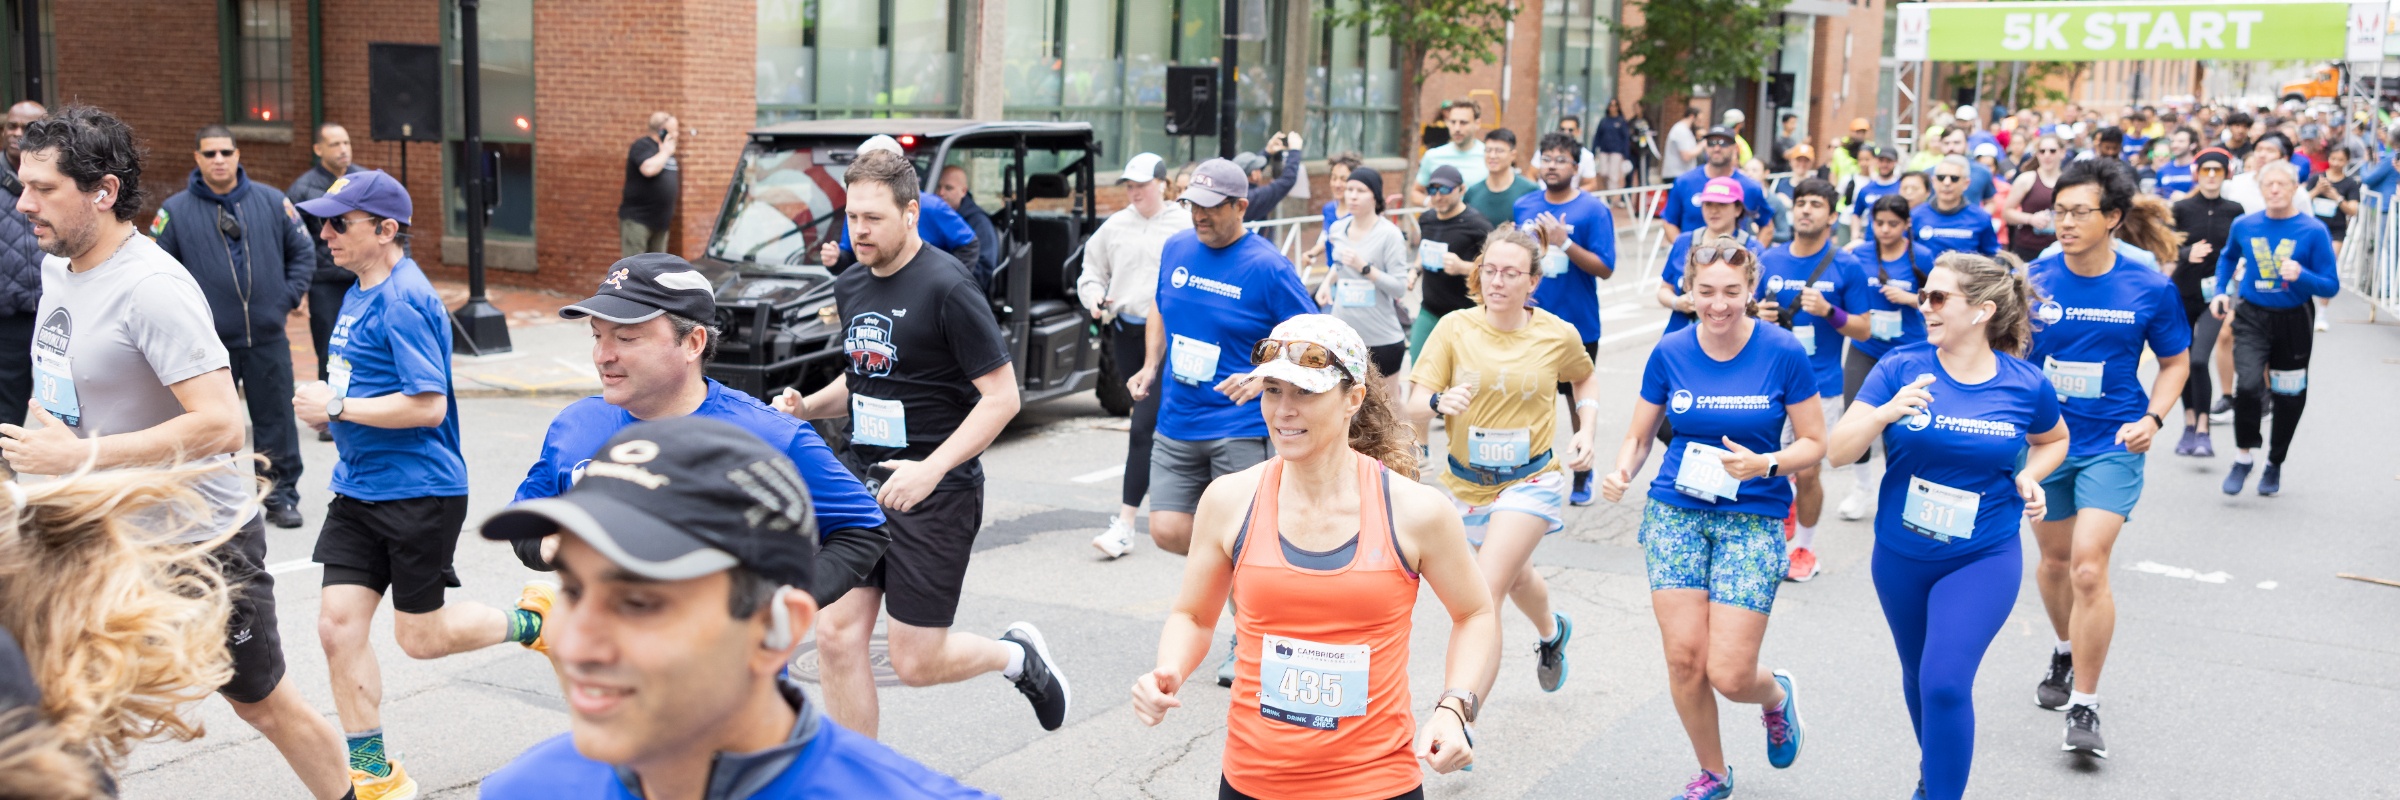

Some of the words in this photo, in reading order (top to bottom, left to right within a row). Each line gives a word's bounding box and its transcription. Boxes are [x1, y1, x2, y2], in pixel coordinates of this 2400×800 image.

[2001, 12, 2070, 51] 5K
[2083, 10, 2264, 51] START
[1176, 352, 1204, 375] 458
[41, 374, 58, 404] 32
[2051, 374, 2087, 393] 999
[860, 414, 889, 440] 959
[1479, 443, 1515, 462] 906
[1686, 461, 1726, 488] 299
[1920, 500, 1955, 529] 311
[1279, 667, 1343, 708] 435
[1262, 707, 1281, 717] DRINK
[1286, 714, 1307, 723] DRINK
[1312, 721, 1335, 729] CHECK
